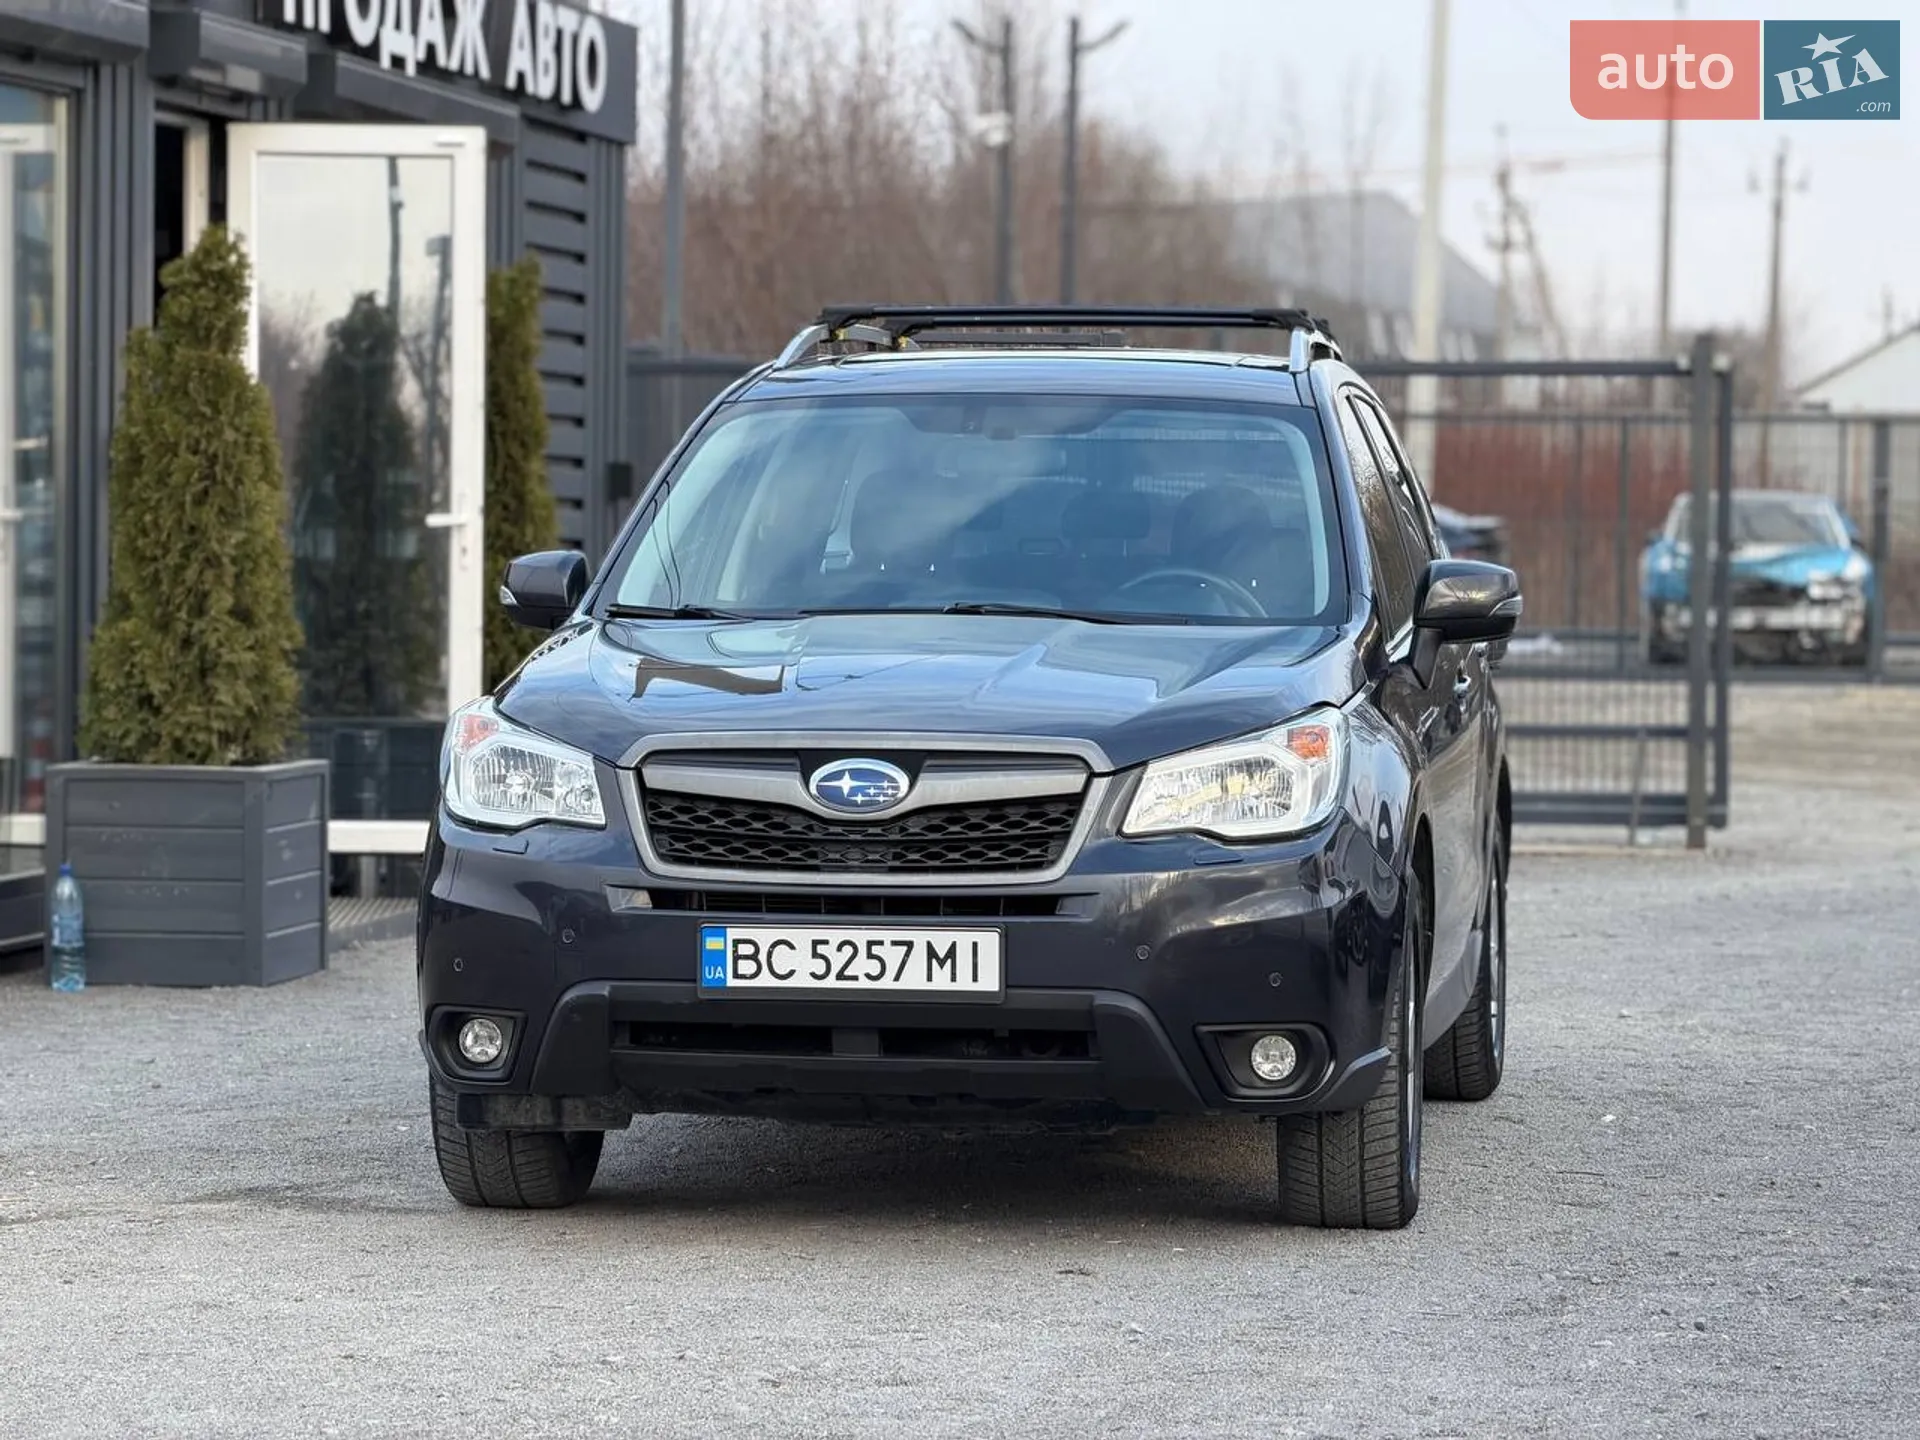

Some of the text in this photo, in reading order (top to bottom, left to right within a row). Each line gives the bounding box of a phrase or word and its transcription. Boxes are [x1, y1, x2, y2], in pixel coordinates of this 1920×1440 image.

[283, 0, 608, 113] ДАЖ АВТО
[705, 966, 725, 980] UA
[732, 938, 979, 983] BC 5257 MI
